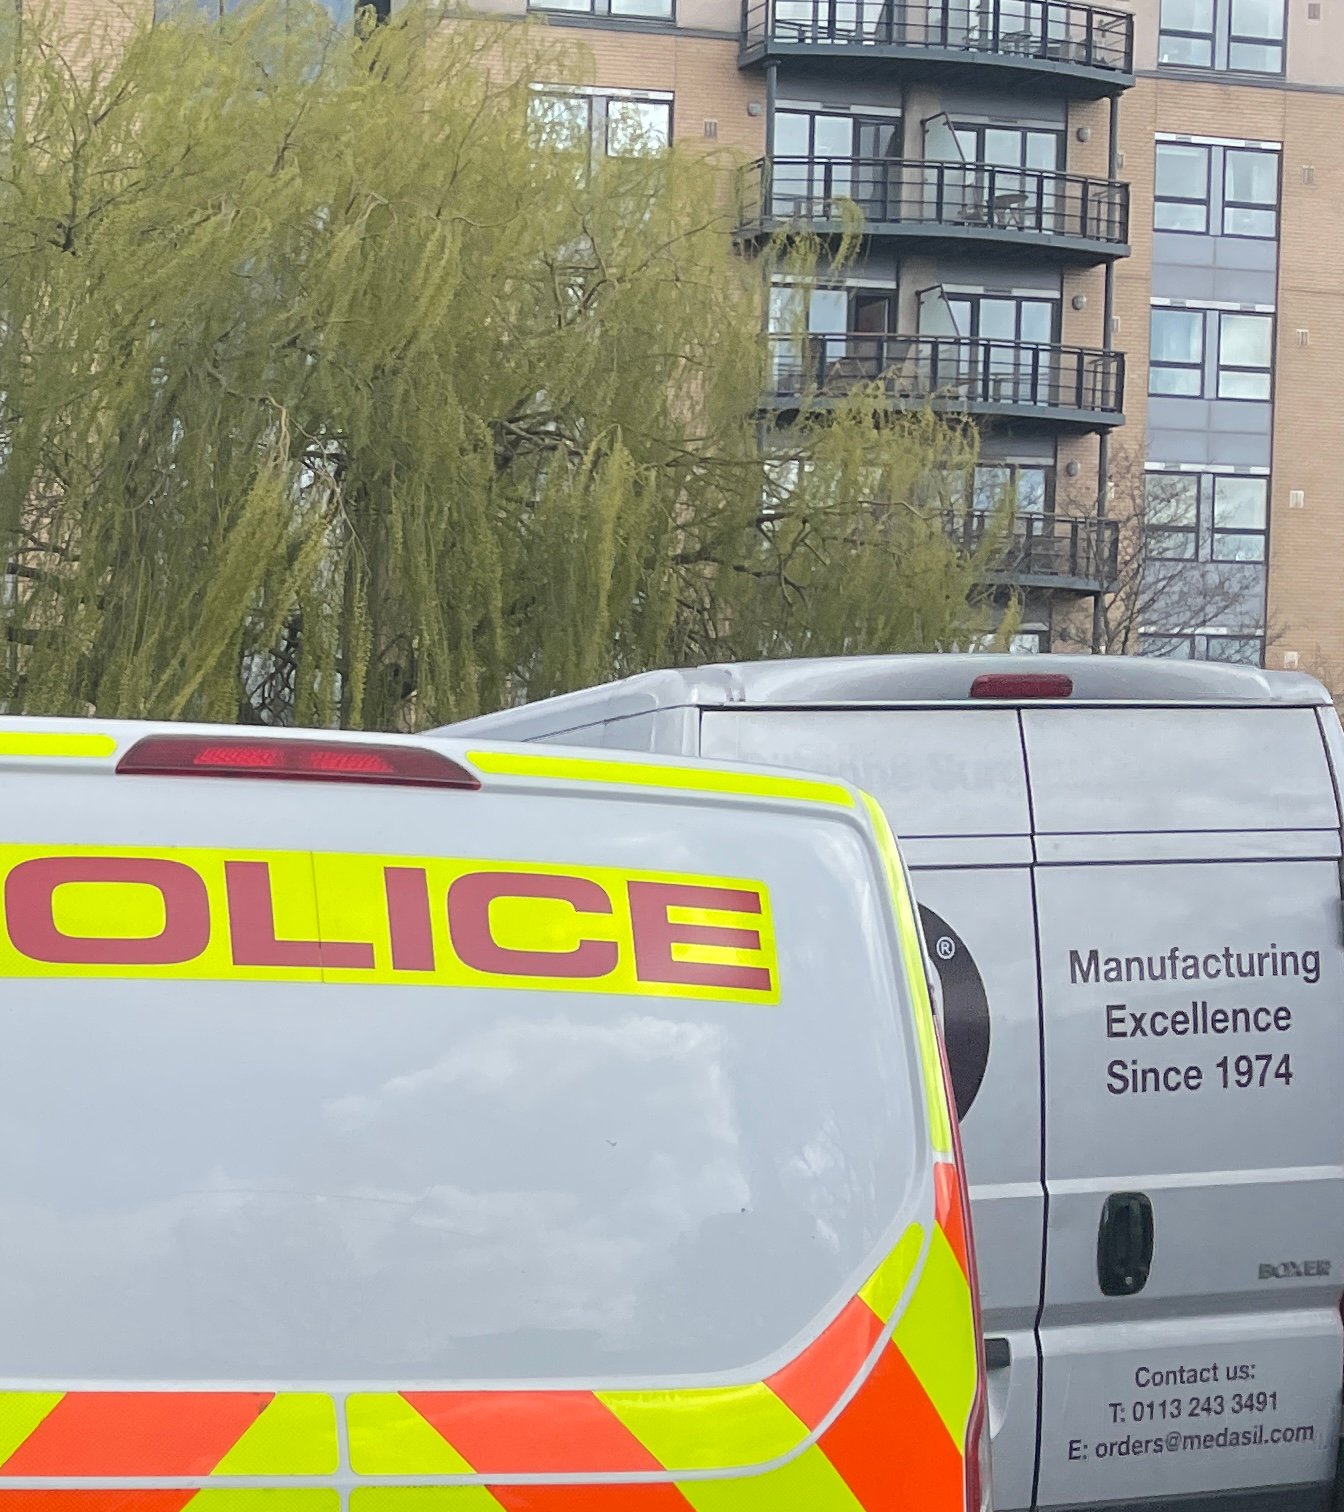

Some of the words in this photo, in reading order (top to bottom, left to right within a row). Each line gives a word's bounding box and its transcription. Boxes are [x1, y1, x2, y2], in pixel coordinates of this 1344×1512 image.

[1069, 943, 1321, 984] Manufacturing
[1106, 1001, 1291, 1038] Excellence
[1107, 1059, 1203, 1094] Since
[1216, 1053, 1293, 1088] 1974
[1258, 1259, 1332, 1280] BOXER
[1134, 1363, 1218, 1388] Contact
[1226, 1363, 1256, 1380] us:
[1109, 1402, 1126, 1423] T:
[1132, 1399, 1182, 1422] 0113
[1188, 1395, 1225, 1417] 243
[1231, 1391, 1278, 1414] 3491
[1068, 1439, 1088, 1460] E:
[1095, 1424, 1314, 1459] orders@medasil.com
